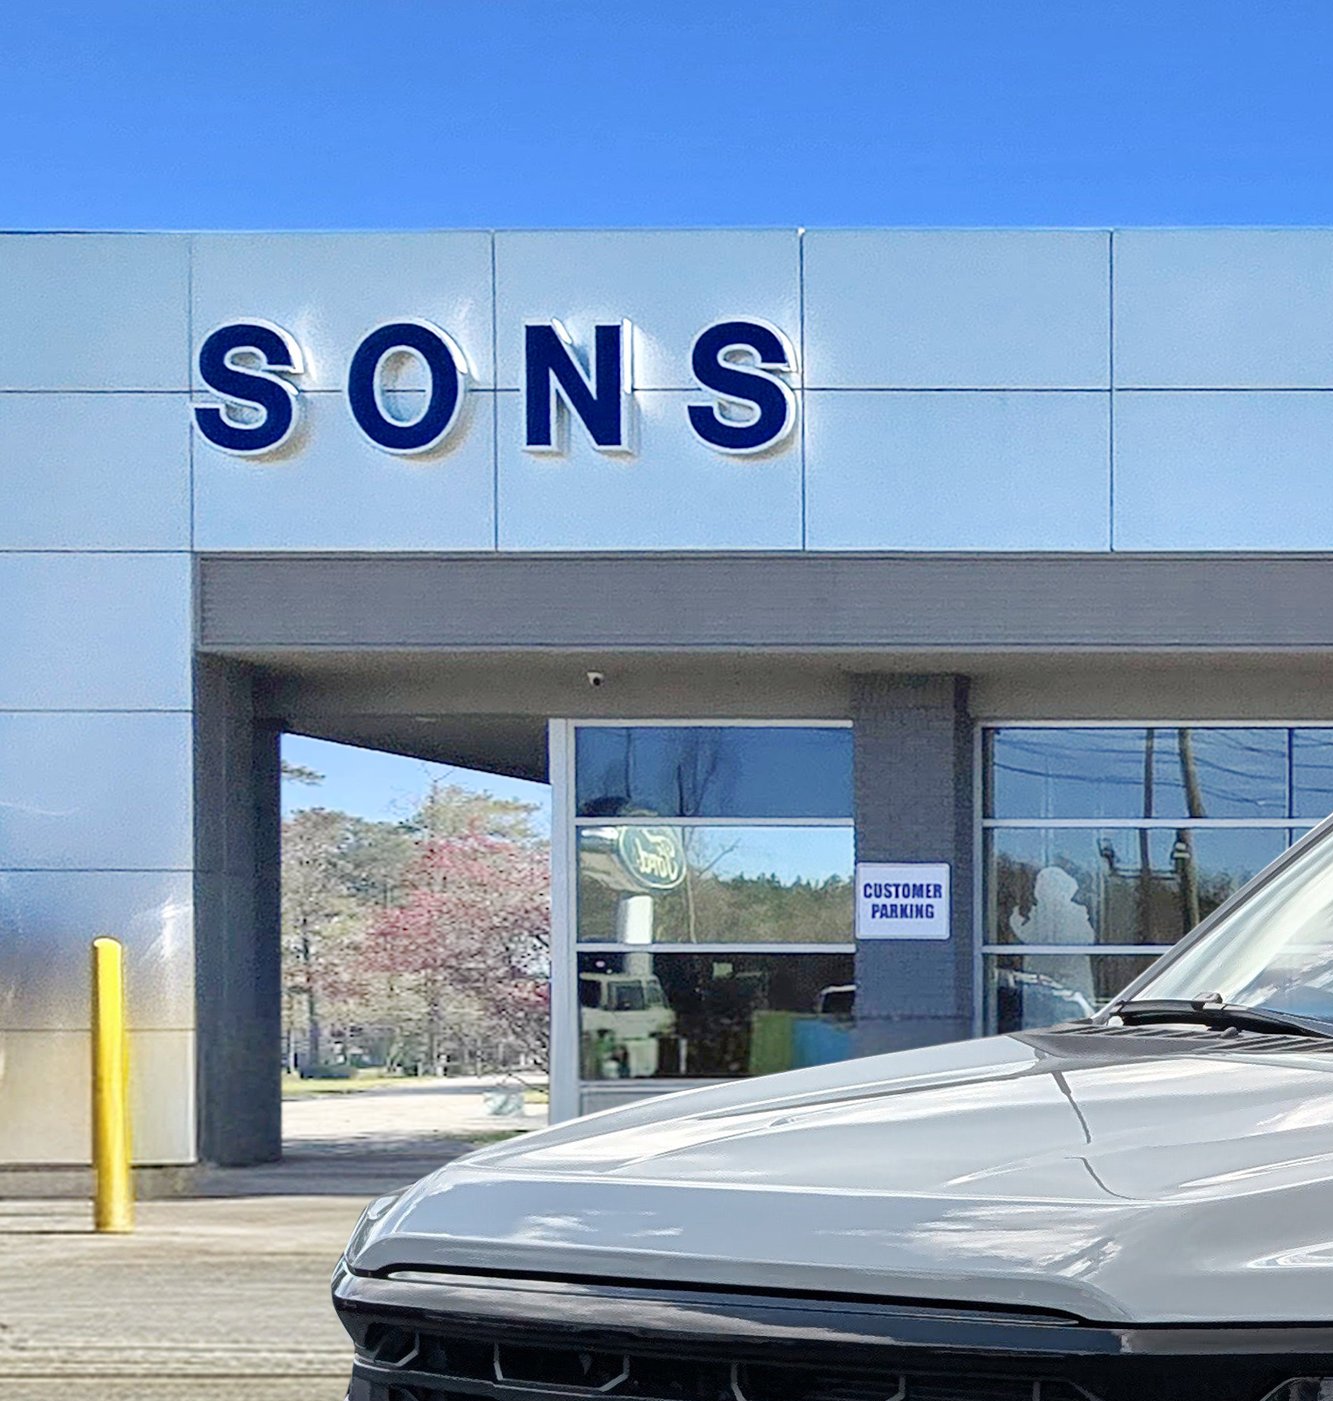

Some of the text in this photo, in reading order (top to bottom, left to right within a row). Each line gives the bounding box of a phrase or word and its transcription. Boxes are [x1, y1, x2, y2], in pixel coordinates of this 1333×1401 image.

[194, 320, 797, 453] SONS
[863, 882, 943, 899] CUSTOMER
[871, 903, 935, 919] PARKING
